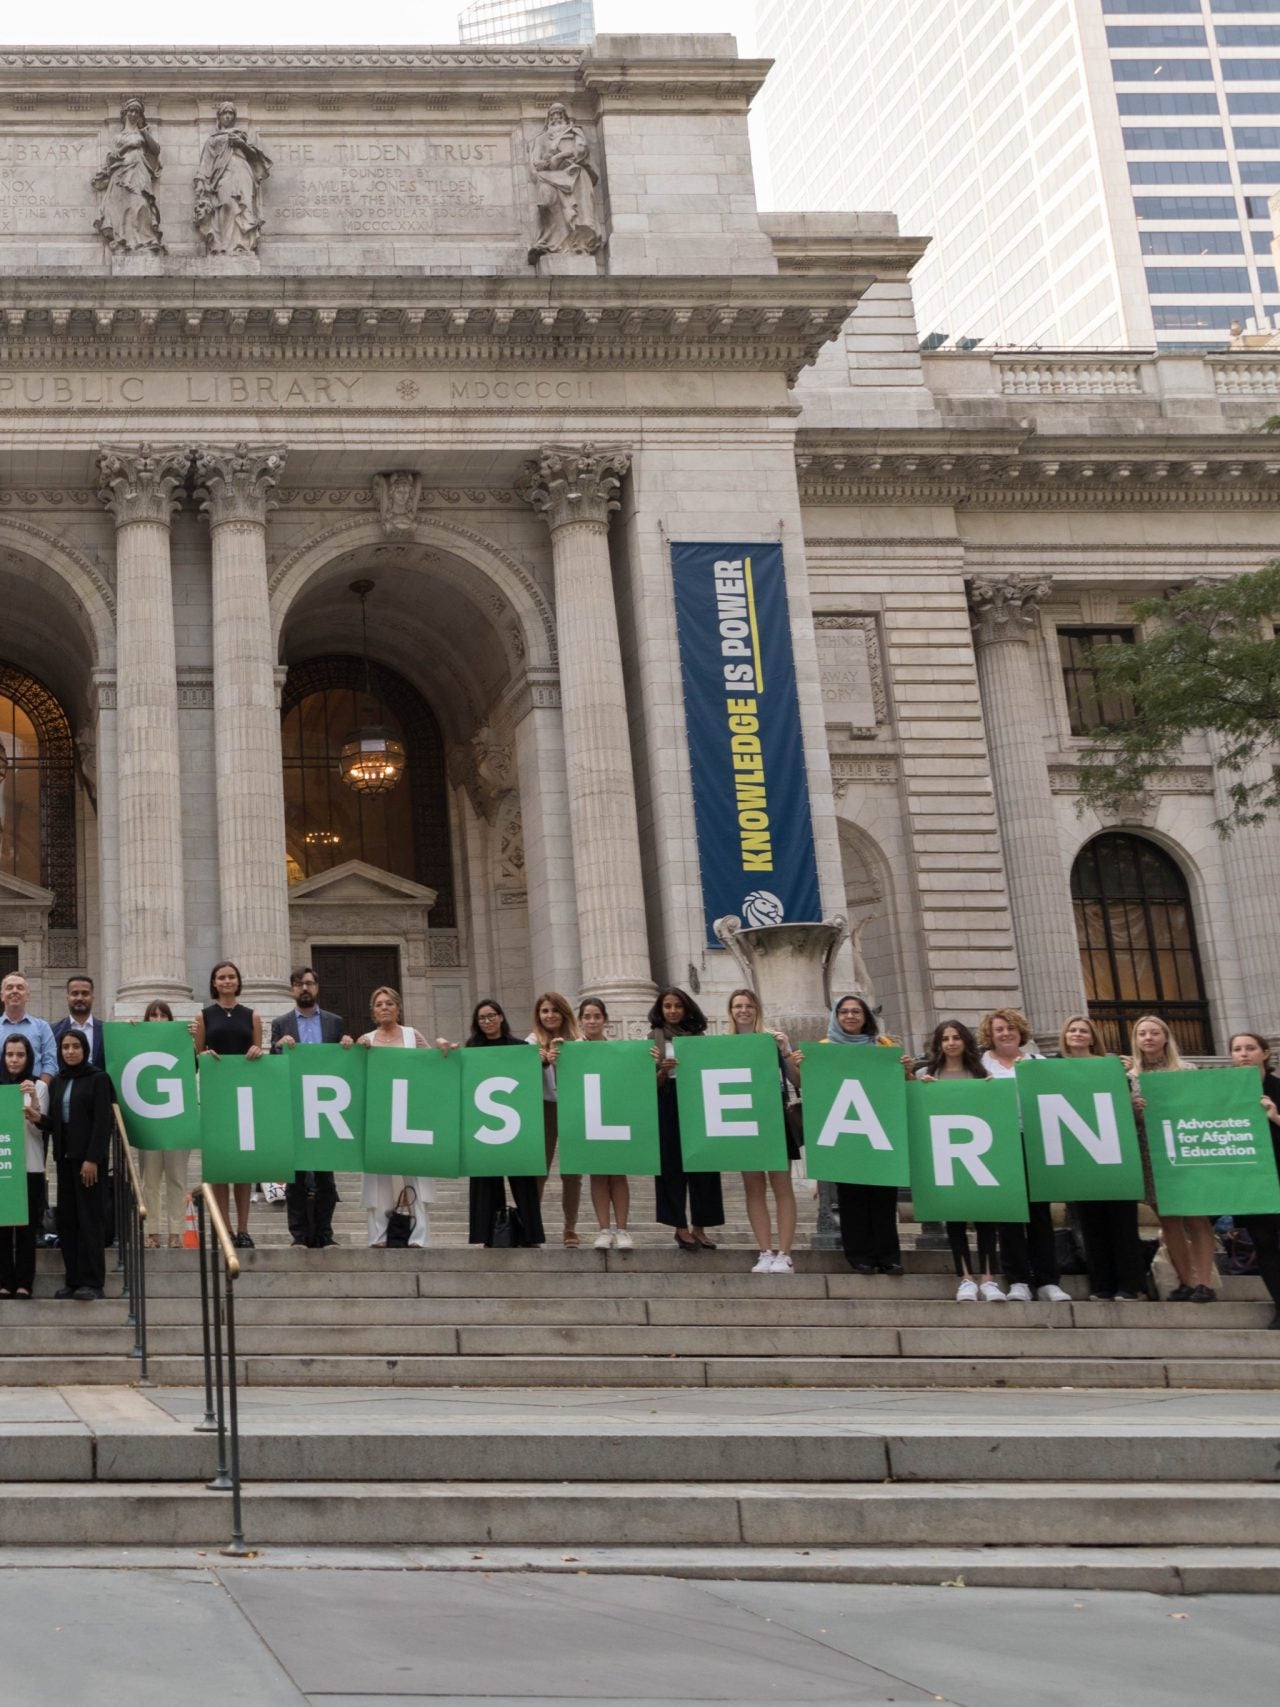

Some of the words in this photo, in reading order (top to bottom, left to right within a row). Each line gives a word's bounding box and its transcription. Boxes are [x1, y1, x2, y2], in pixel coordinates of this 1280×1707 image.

[273, 144, 314, 161] THE
[333, 144, 410, 161] TILDEN
[428, 144, 498, 161] TRUST
[2, 168, 17, 178] BY
[342, 168, 401, 178] FOUNDED
[416, 168, 432, 178] BY
[300, 181, 359, 193] SAMUEL
[367, 181, 417, 193] JONES
[424, 181, 478, 193] TILDEN
[288, 195, 306, 206] TO
[314, 195, 352, 206] SERVE
[360, 195, 385, 206] THE
[391, 195, 462, 206] INTERESTS
[470, 195, 485, 206] OF
[18, 208, 47, 219] FINE
[54, 208, 87, 219] ARTS
[273, 208, 330, 219] SCIENCE
[337, 208, 363, 218] AND
[368, 208, 429, 218] POPULAR
[186, 377, 363, 403] LIBRARY
[713, 560, 752, 657] POWER
[723, 663, 755, 691] IS
[727, 699, 773, 872] KNOWLEDGE
[1177, 1118, 1252, 1130] Advocates
[1178, 1132, 1200, 1144] for
[1201, 1131, 1254, 1145] Afghan
[1181, 1145, 1257, 1157] Education
